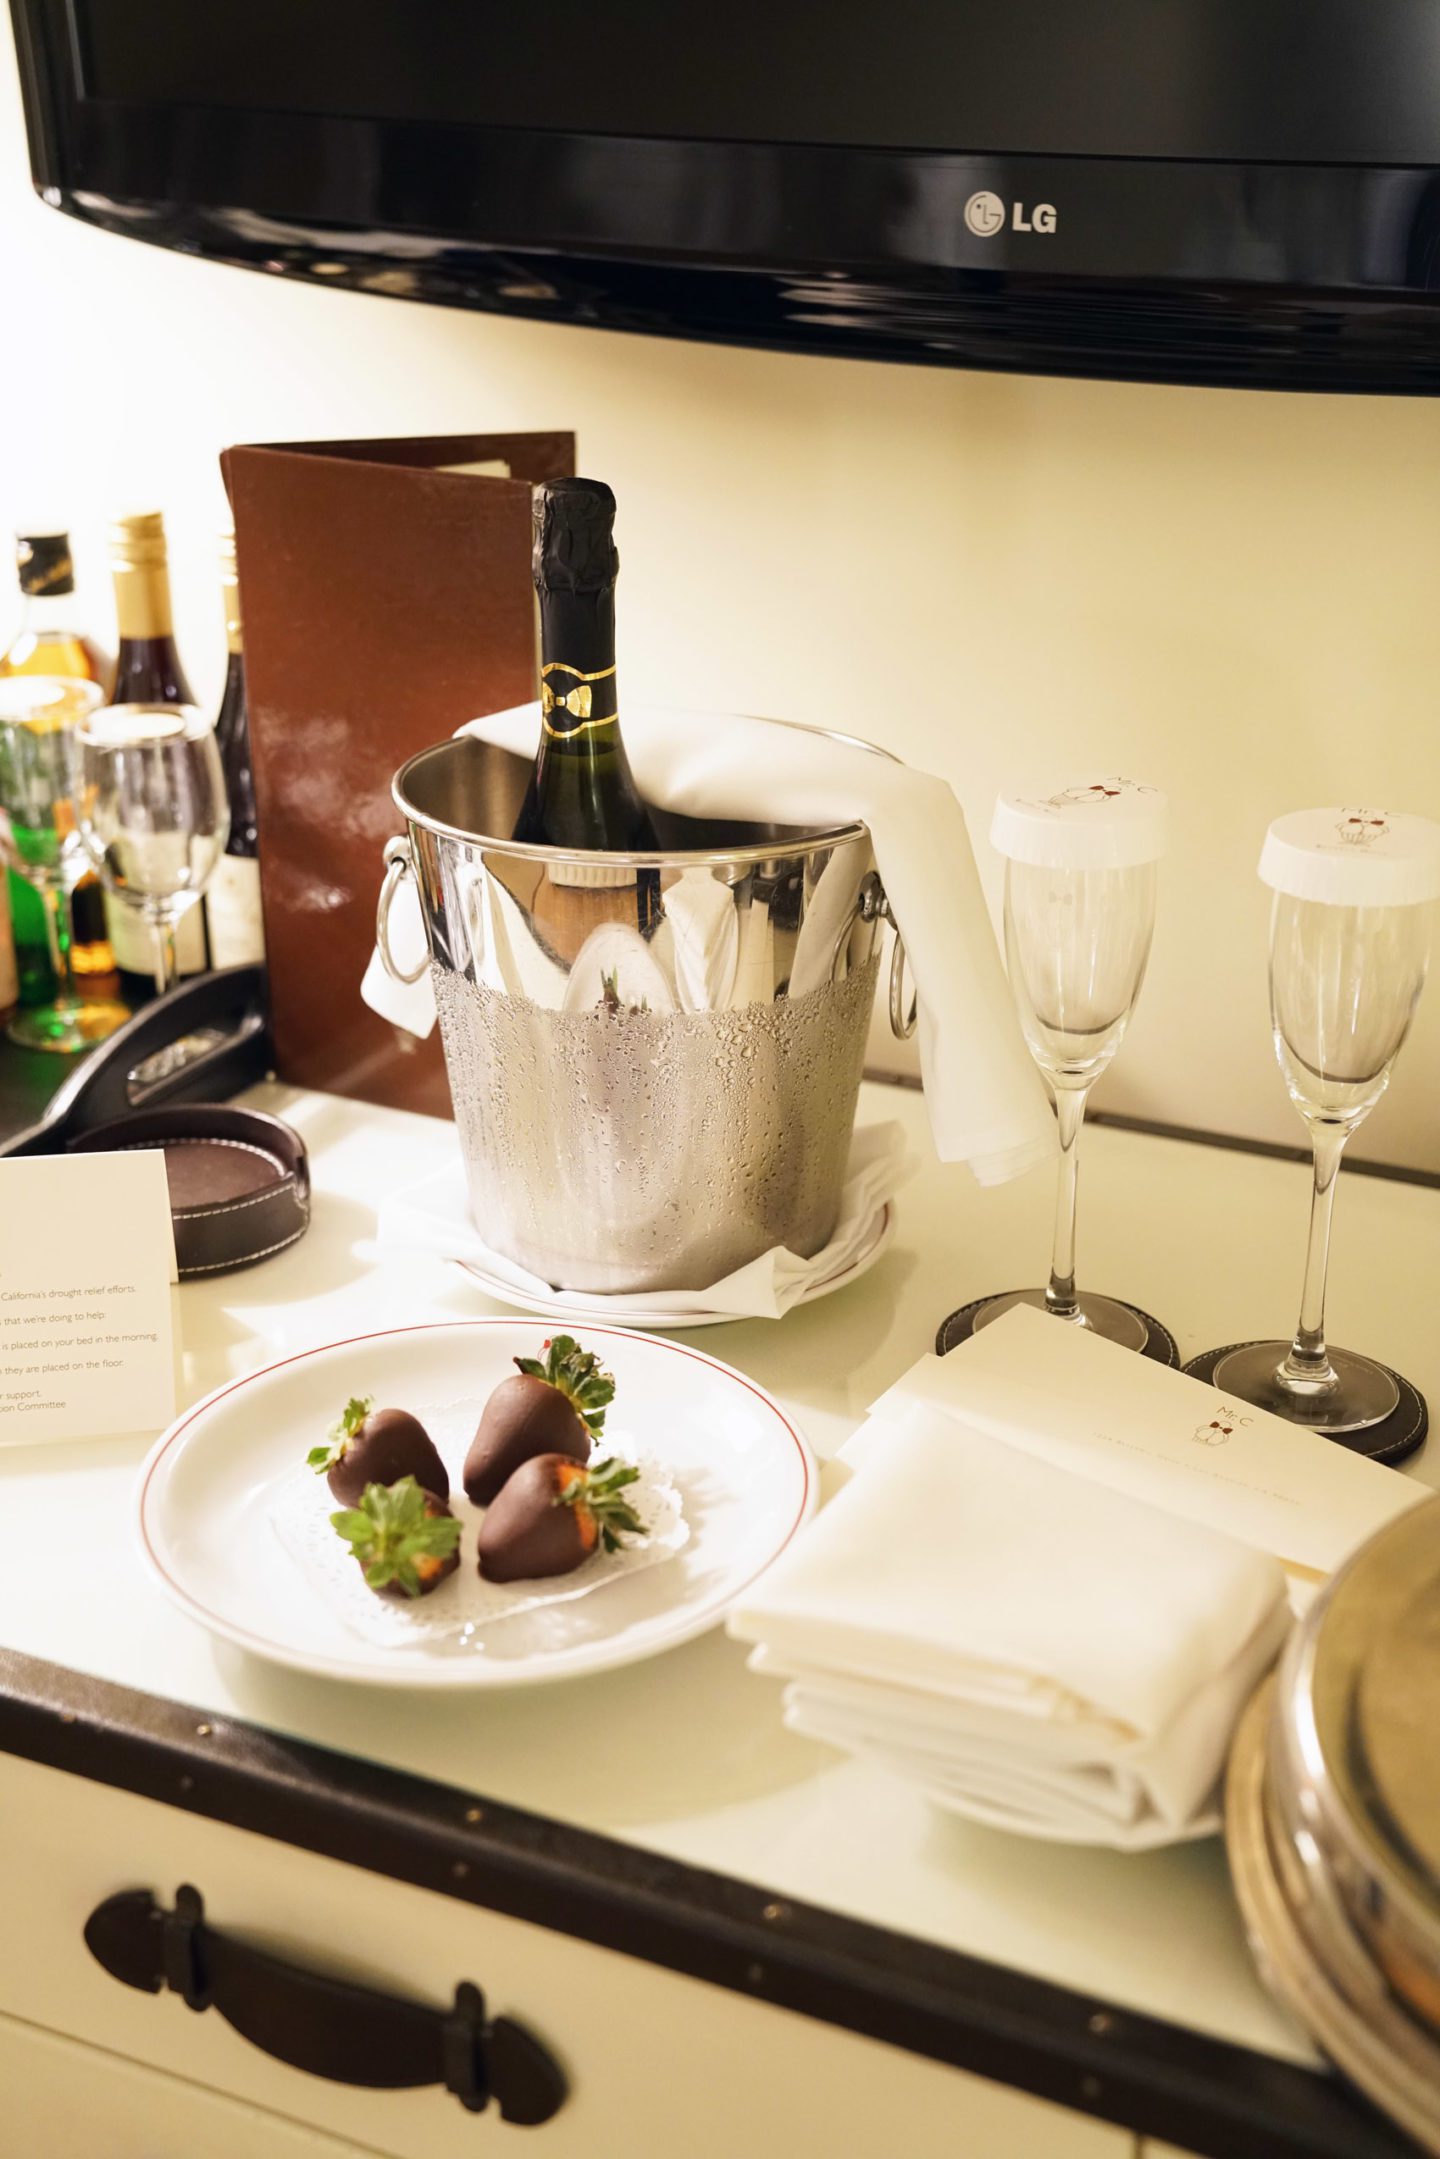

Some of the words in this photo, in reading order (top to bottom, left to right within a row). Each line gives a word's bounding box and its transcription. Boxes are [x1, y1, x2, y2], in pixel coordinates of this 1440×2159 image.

[1012, 202, 1057, 233] LG
[1, 1291, 46, 1302] California's
[49, 1288, 82, 1299] drought
[85, 1285, 105, 1296] relief
[107, 1285, 136, 1294] efforts.
[4, 1317, 21, 1325] that
[23, 1315, 46, 1324] we're
[48, 1313, 73, 1324] doing
[75, 1313, 85, 1321] to
[11, 1340, 39, 1351] placed
[55, 1339, 74, 1349] your
[76, 1336, 93, 1345] bed
[105, 1334, 120, 1343] the
[122, 1332, 159, 1343] morning.
[4, 1367, 24, 1377] they
[42, 1362, 70, 1374] placed
[72, 1362, 84, 1370] on
[86, 1360, 100, 1369] the
[103, 1359, 124, 1368] floor.
[6, 1390, 42, 1401] support.
[17, 1401, 67, 1411] Committee
[1216, 1406, 1238, 1420] Mr.
[1240, 1417, 1254, 1427] C
